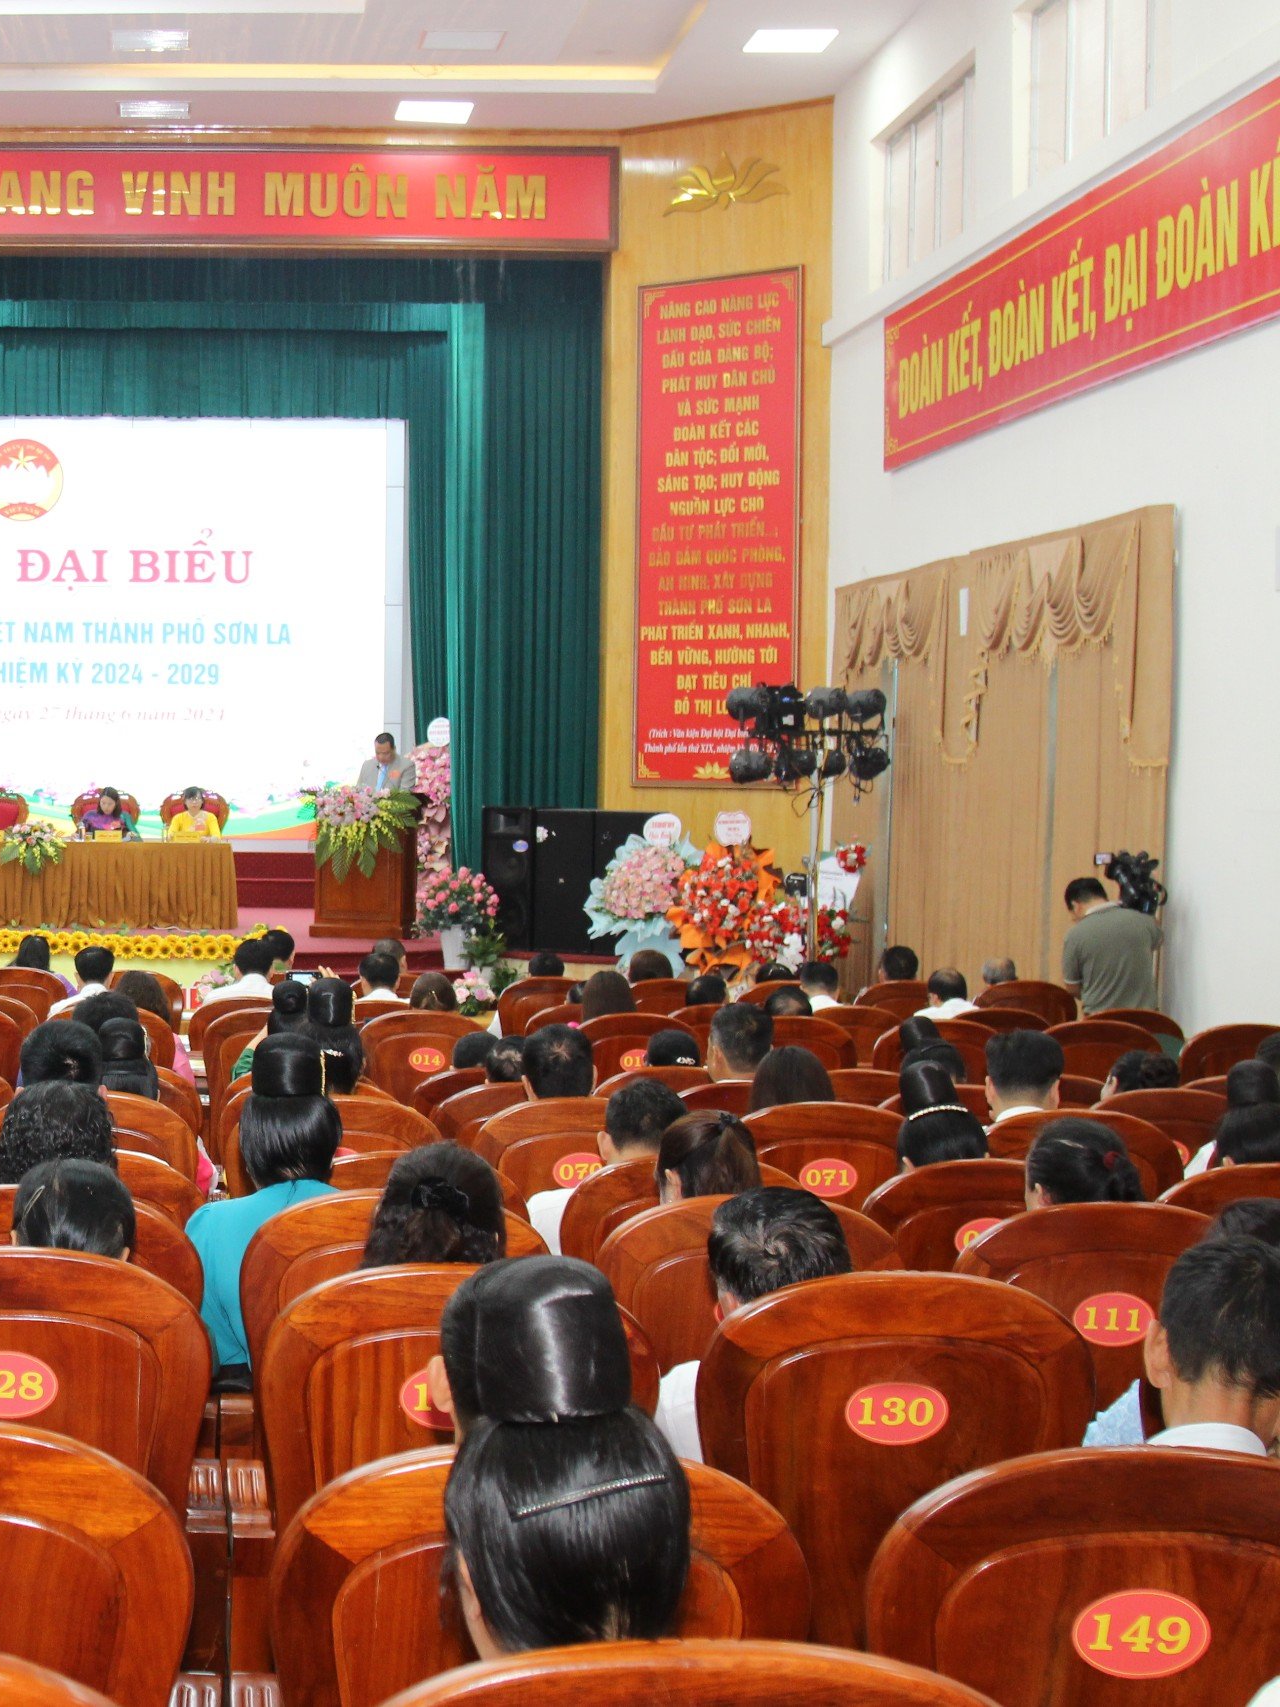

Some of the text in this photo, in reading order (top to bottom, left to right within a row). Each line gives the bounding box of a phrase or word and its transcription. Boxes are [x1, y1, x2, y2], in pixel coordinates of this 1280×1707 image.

[121, 170, 235, 216] VINH
[263, 163, 408, 219] MUÔN
[434, 165, 546, 220] NĂM
[898, 334, 943, 419] ĐOÀN
[947, 300, 983, 396] KẾT,
[988, 279, 1044, 378] ĐOÀN
[1051, 237, 1096, 347] KẾT,
[1103, 227, 1147, 332] ĐẠI
[1156, 177, 1239, 299] ĐOÀN
[657, 468, 780, 493] SÁNG TẠO; HUY ĐỘNG
[16, 548, 109, 591] ĐẠI
[128, 528, 254, 584] BIỂU
[23, 620, 75, 645] NAM
[82, 614, 154, 645] THÀNH
[162, 611, 206, 645] PHỐ
[213, 618, 259, 646] SƠN
[265, 623, 292, 646] LA
[640, 619, 790, 641] PHÁT TRIỂN XANH, NHANH,
[650, 645, 777, 667] BỀN VỮNG, HƯỚNG TỚI
[55, 656, 84, 685] KỲ
[91, 662, 142, 686] 2024
[167, 662, 220, 686] 2029
[676, 670, 752, 693] ĐẠT TIÊU CHÍ
[412, 1053, 441, 1066] 014
[623, 1055, 642, 1067] 01
[805, 1169, 850, 1186] 071
[1082, 1306, 1141, 1333] 111
[857, 1395, 935, 1427] 130
[1087, 1613, 1192, 1655] 149
